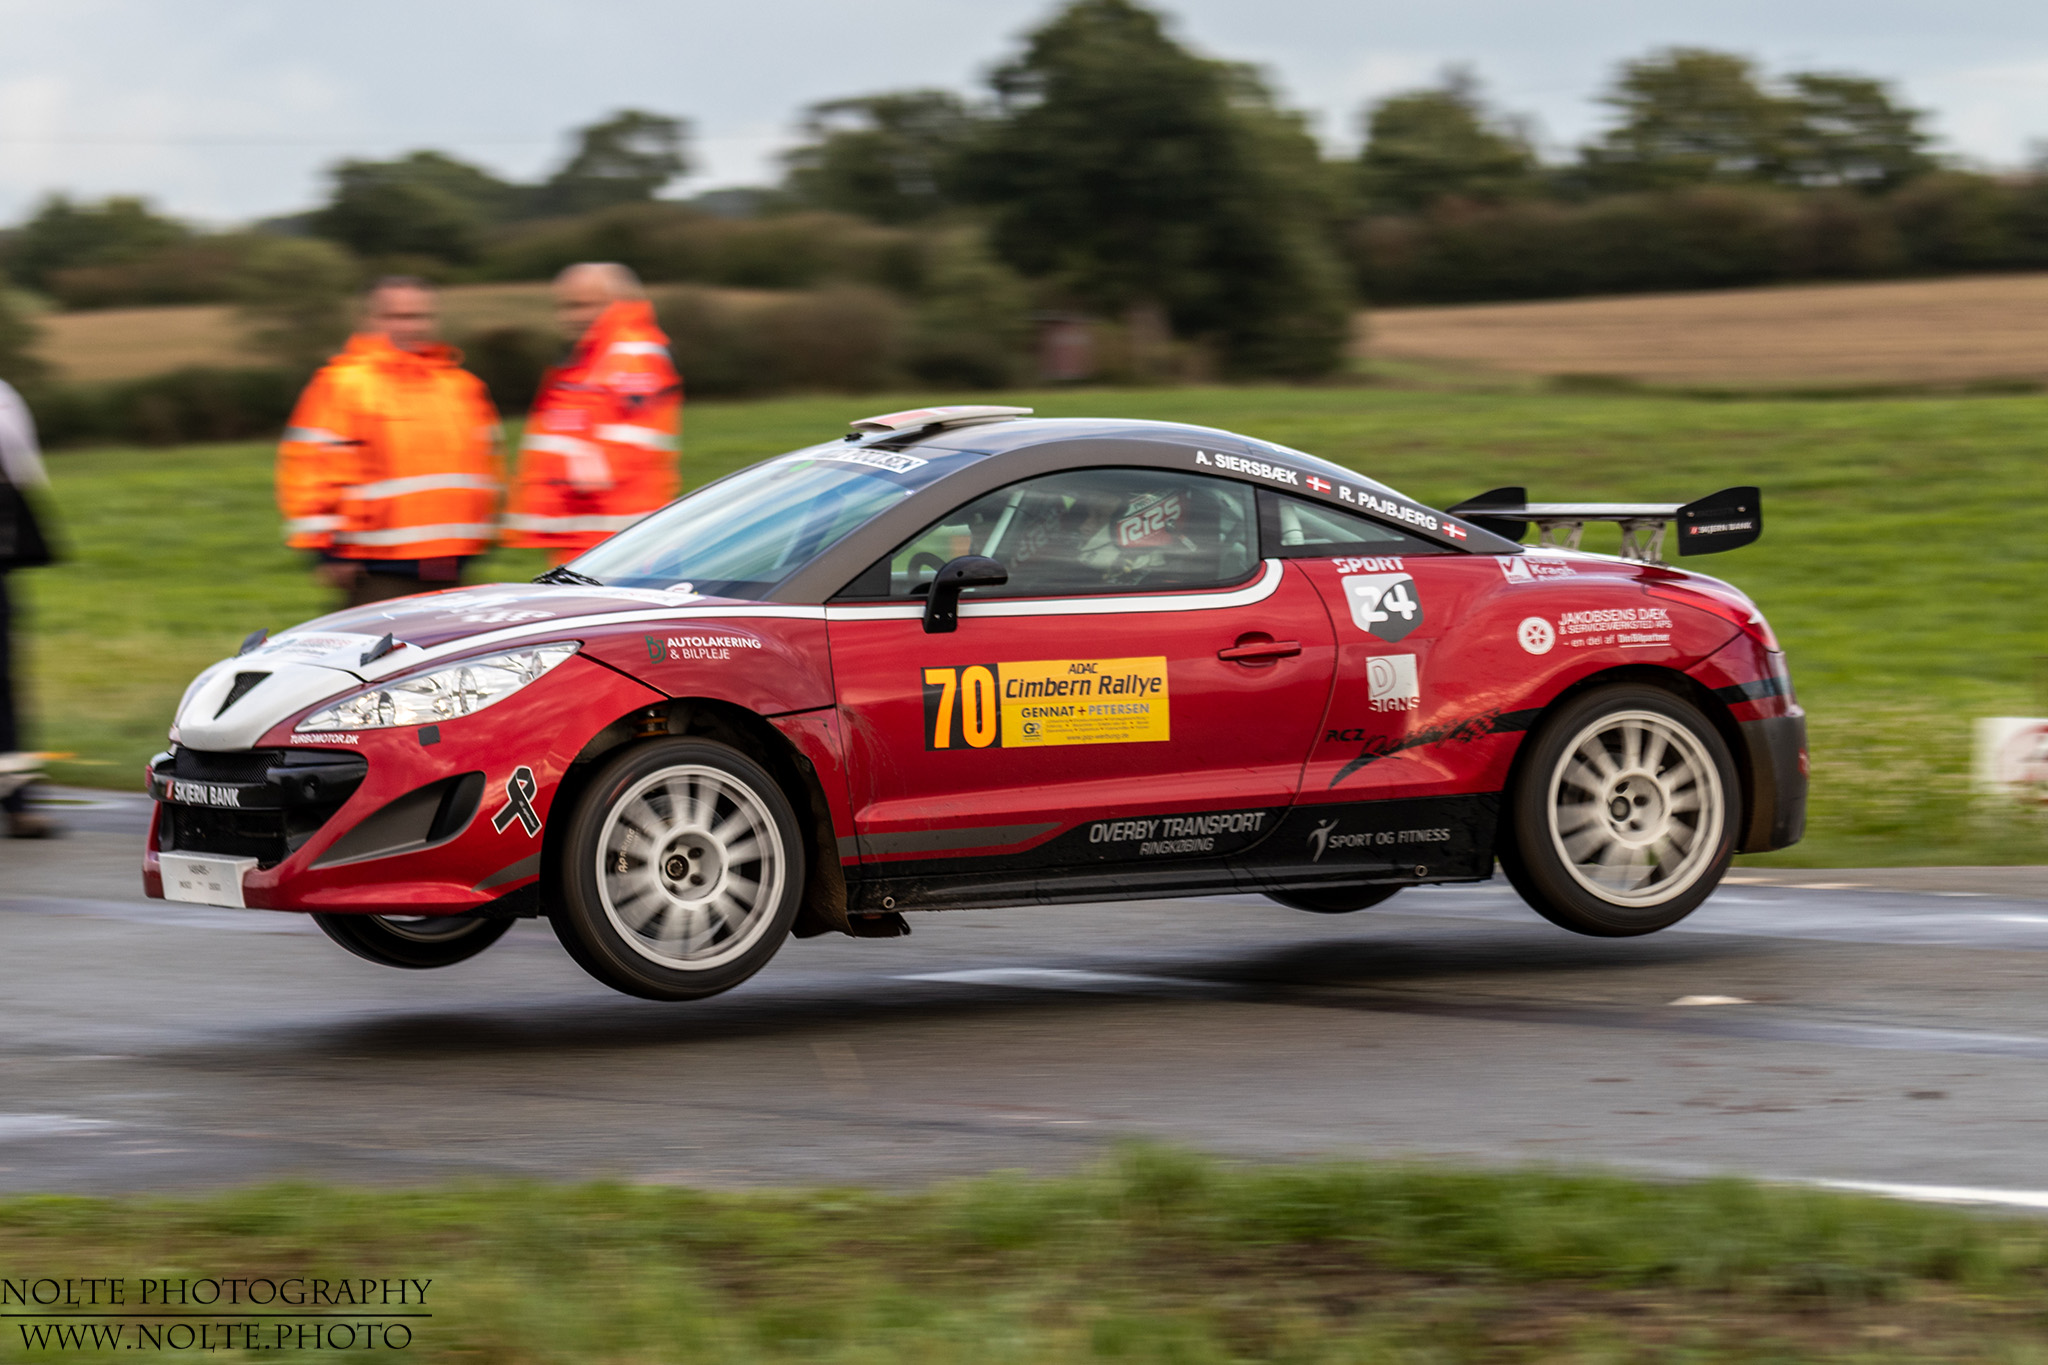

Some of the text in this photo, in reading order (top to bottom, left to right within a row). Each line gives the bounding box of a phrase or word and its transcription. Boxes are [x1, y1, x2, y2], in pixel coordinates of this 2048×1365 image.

[1196, 450, 1438, 530] A. SIERSBÆK R. PAJBJERG
[1332, 557, 1405, 573] SPORT
[1355, 584, 1417, 622] 24
[1558, 608, 1669, 626] JAKOBSENS DÆK
[667, 636, 762, 649] AUTOLAKERING
[670, 648, 731, 660] & BILPLEJE
[1068, 662, 1099, 674] ADAC
[1006, 674, 1162, 698] Cimbern Rallye
[924, 665, 997, 748] 70
[1021, 706, 1075, 718] GENNAT
[1088, 703, 1151, 716] PETERSEN
[1368, 697, 1421, 712] SIGNS
[290, 733, 359, 745] TURBOMOTOR.DK
[1325, 728, 1366, 742] RCZ
[174, 781, 241, 808] SKJERN BANK
[1089, 812, 1266, 843] OVERBY TRANSPORT
[1139, 837, 1215, 856] RINGKØBING
[1328, 828, 1451, 849] SPORT OG FITNESS
